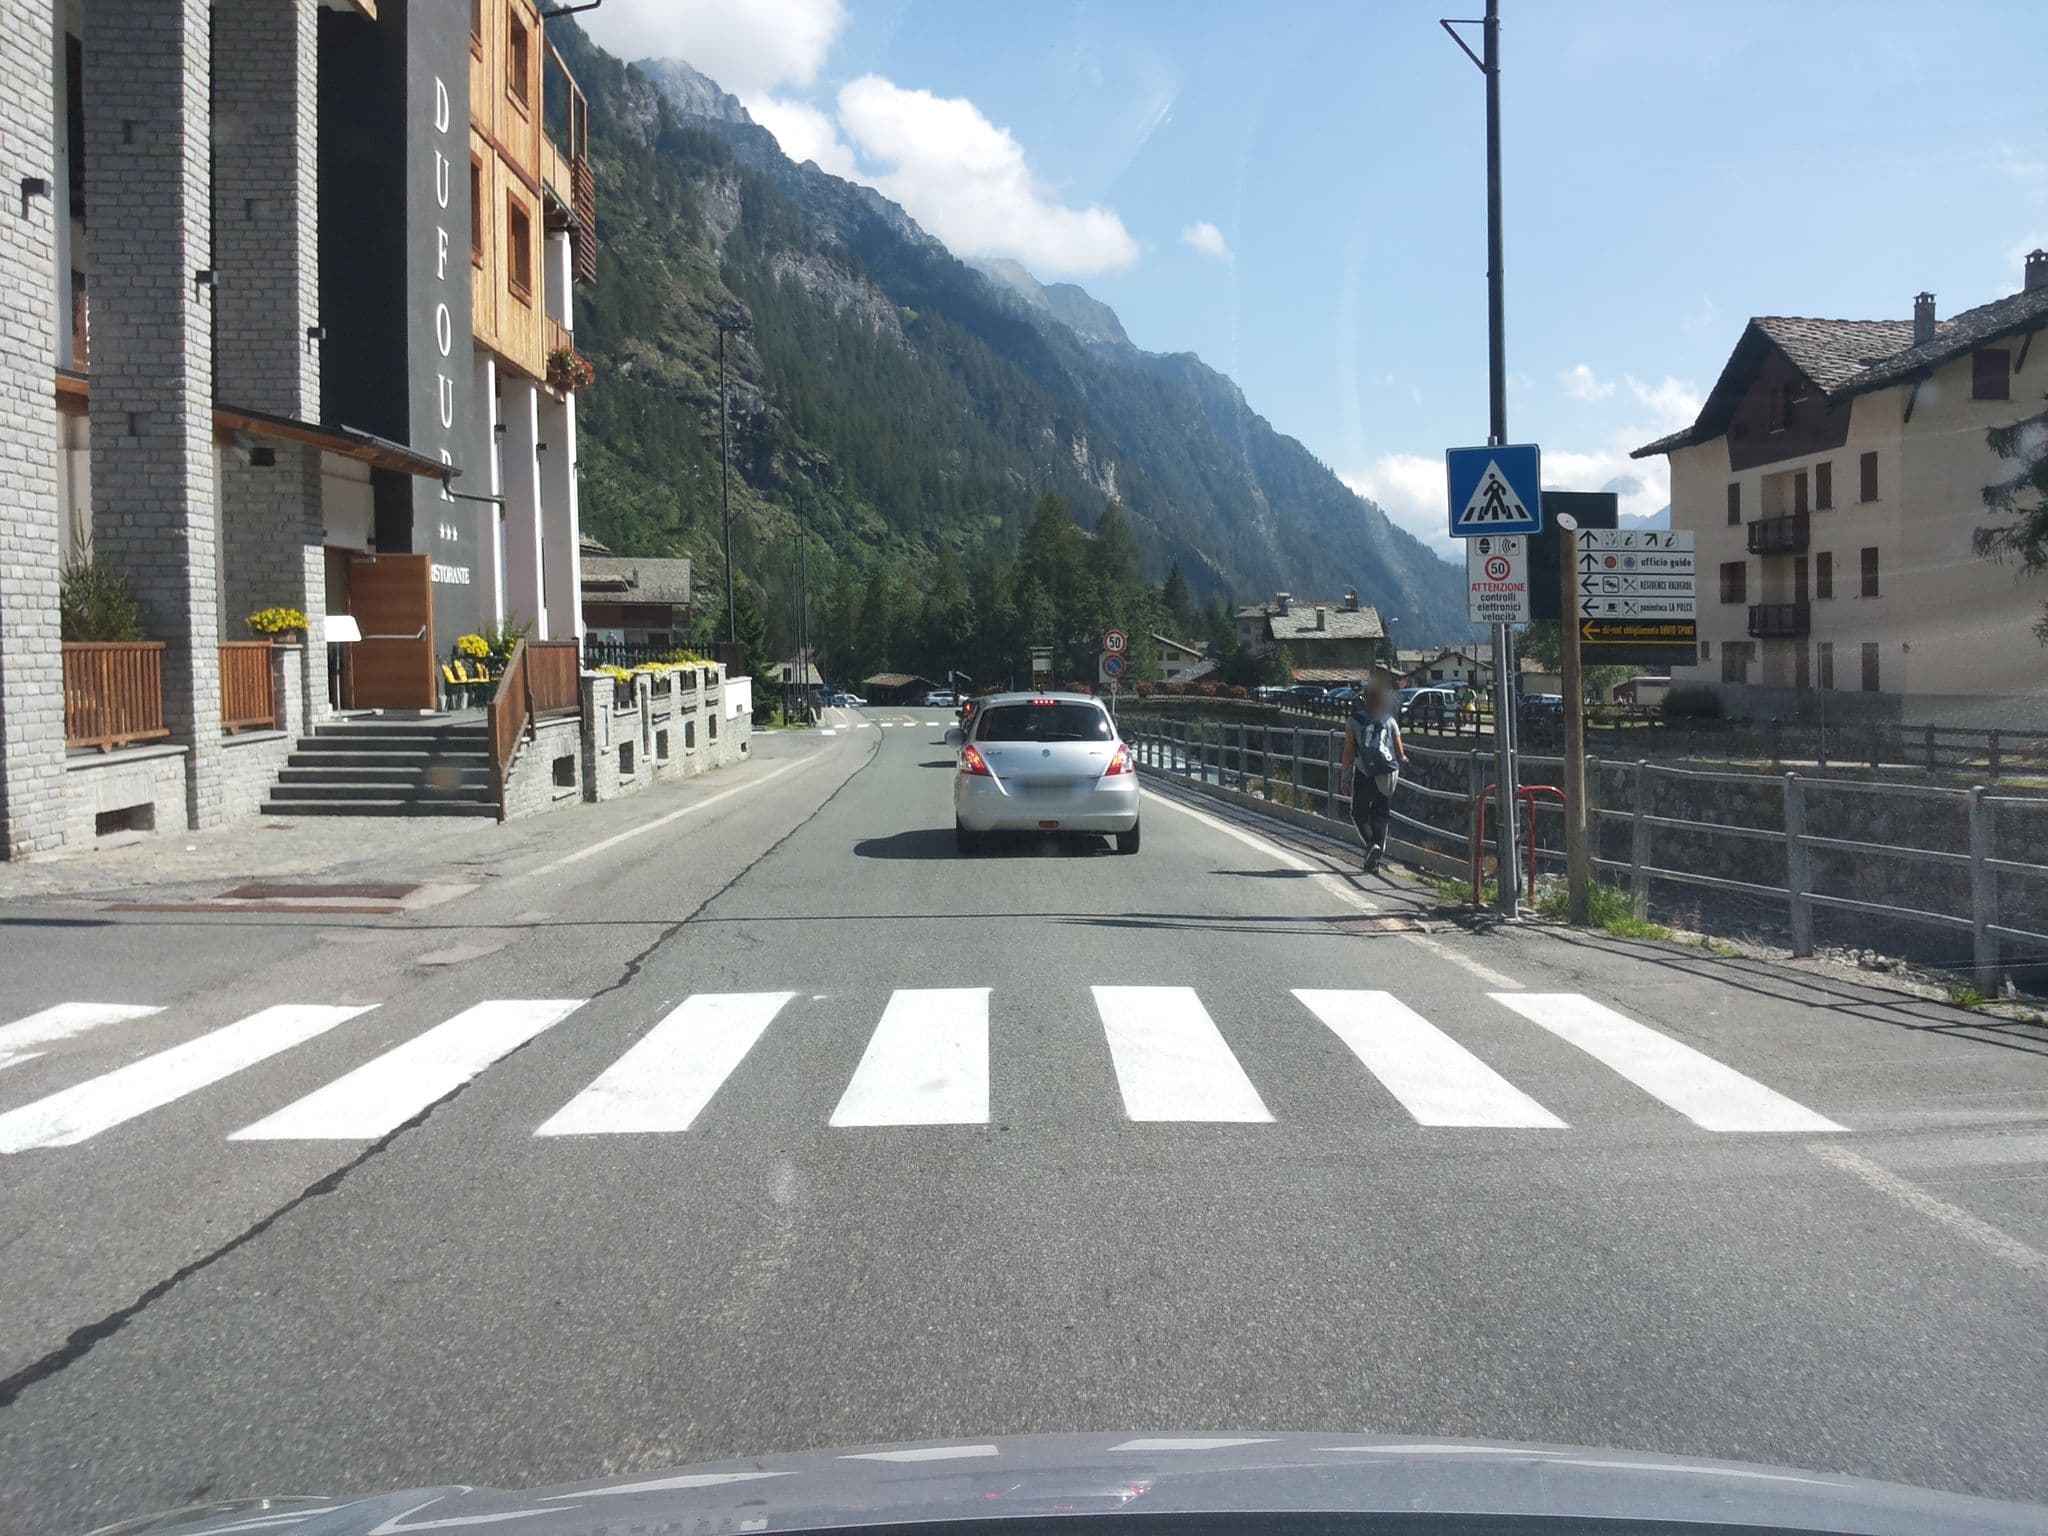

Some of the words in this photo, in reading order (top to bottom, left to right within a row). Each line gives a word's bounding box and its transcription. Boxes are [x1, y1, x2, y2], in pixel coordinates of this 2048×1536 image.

[435, 76, 455, 503] DUFOUR
[1491, 563, 1505, 575] 50
[1471, 582, 1526, 592] ATTENZIONE
[1480, 593, 1516, 602] controlli
[1477, 602, 1521, 611] elettronici
[1482, 612, 1517, 621] velocità
[1109, 637, 1121, 649] 50
